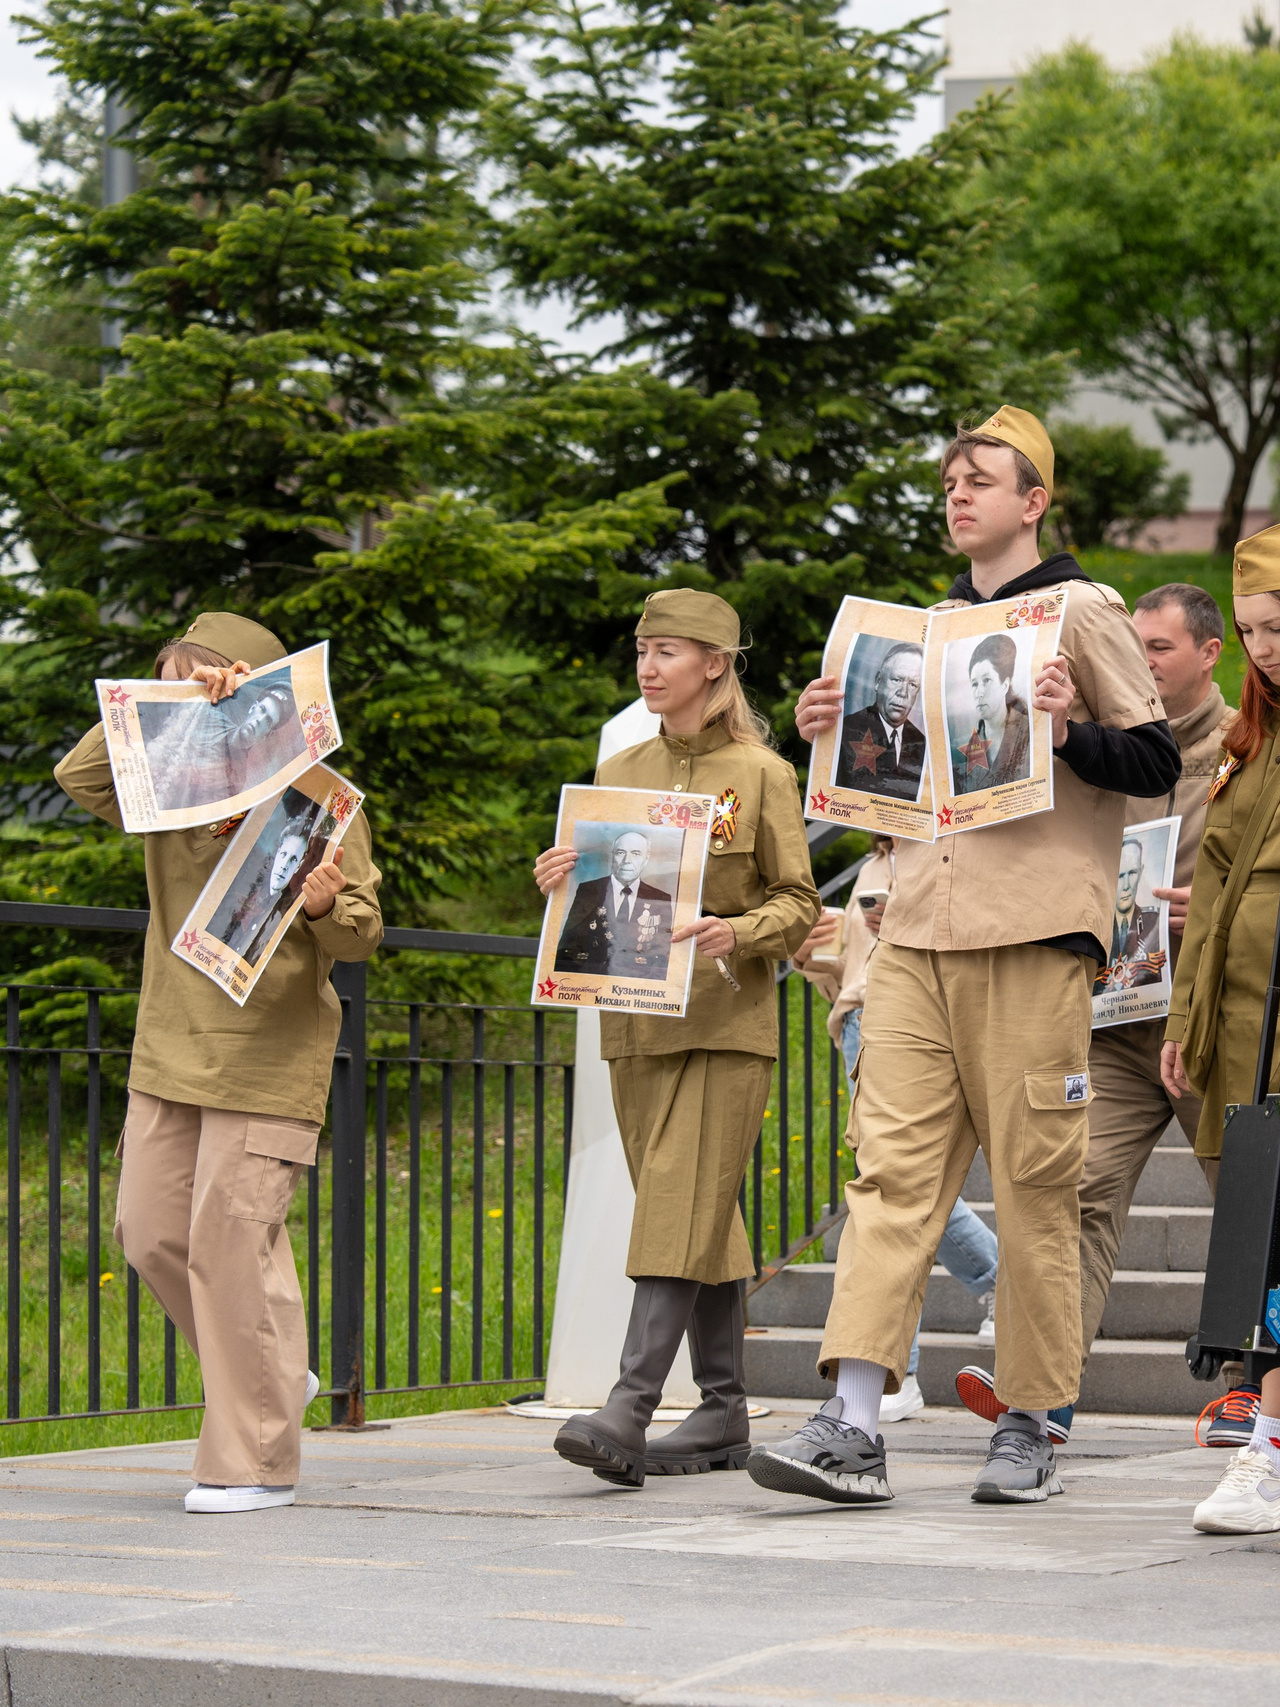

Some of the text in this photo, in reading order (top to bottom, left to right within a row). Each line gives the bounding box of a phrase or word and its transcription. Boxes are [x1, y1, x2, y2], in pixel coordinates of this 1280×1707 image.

[1031, 604, 1045, 625] 9
[305, 725, 326, 744] 9
[676, 805, 691, 828] 9
[829, 807, 852, 818] ПОЛК
[954, 814, 974, 825] ПОЛК
[558, 992, 581, 1001] ПОЛК
[611, 984, 667, 998] Кузьминых
[594, 995, 681, 1012] Михаил Иванович
[1101, 993, 1139, 1006] Чернаков
[1118, 999, 1169, 1015] Николаевич
